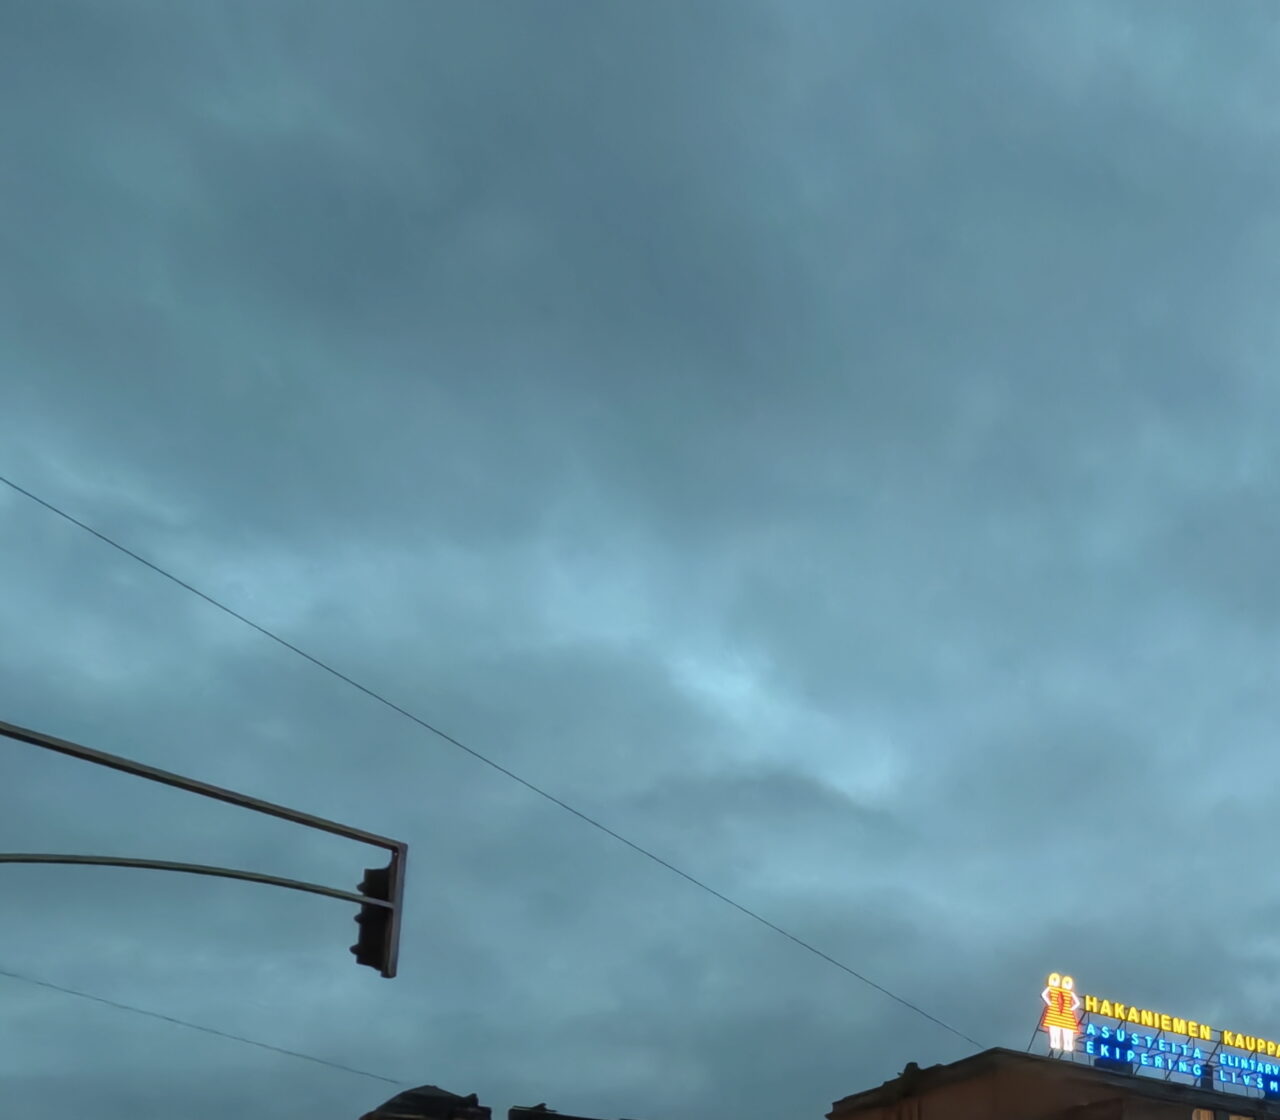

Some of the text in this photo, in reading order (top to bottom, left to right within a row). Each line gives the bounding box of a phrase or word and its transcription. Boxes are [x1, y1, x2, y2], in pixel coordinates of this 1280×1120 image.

[1085, 995, 1211, 1040] HAKANIEMEN
[1086, 1024, 1201, 1059] ASUSTEITA
[1086, 1041, 1202, 1076] EKIPERING
